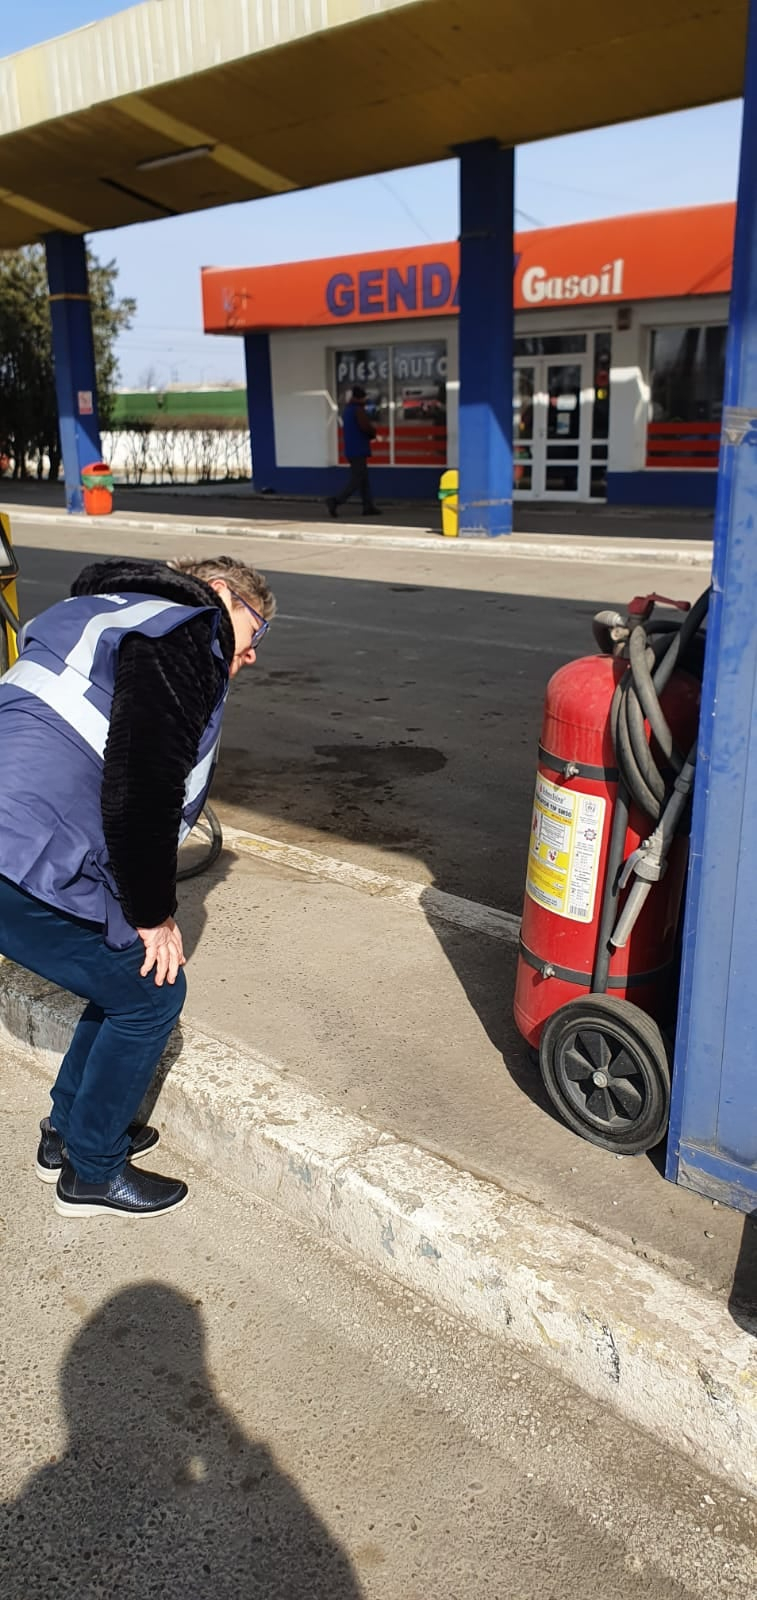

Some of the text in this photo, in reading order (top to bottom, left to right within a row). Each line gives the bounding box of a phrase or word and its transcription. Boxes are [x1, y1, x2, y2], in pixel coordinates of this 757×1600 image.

[521, 258, 624, 303] Gasoil
[338, 356, 448, 382] PIESE AUTO
